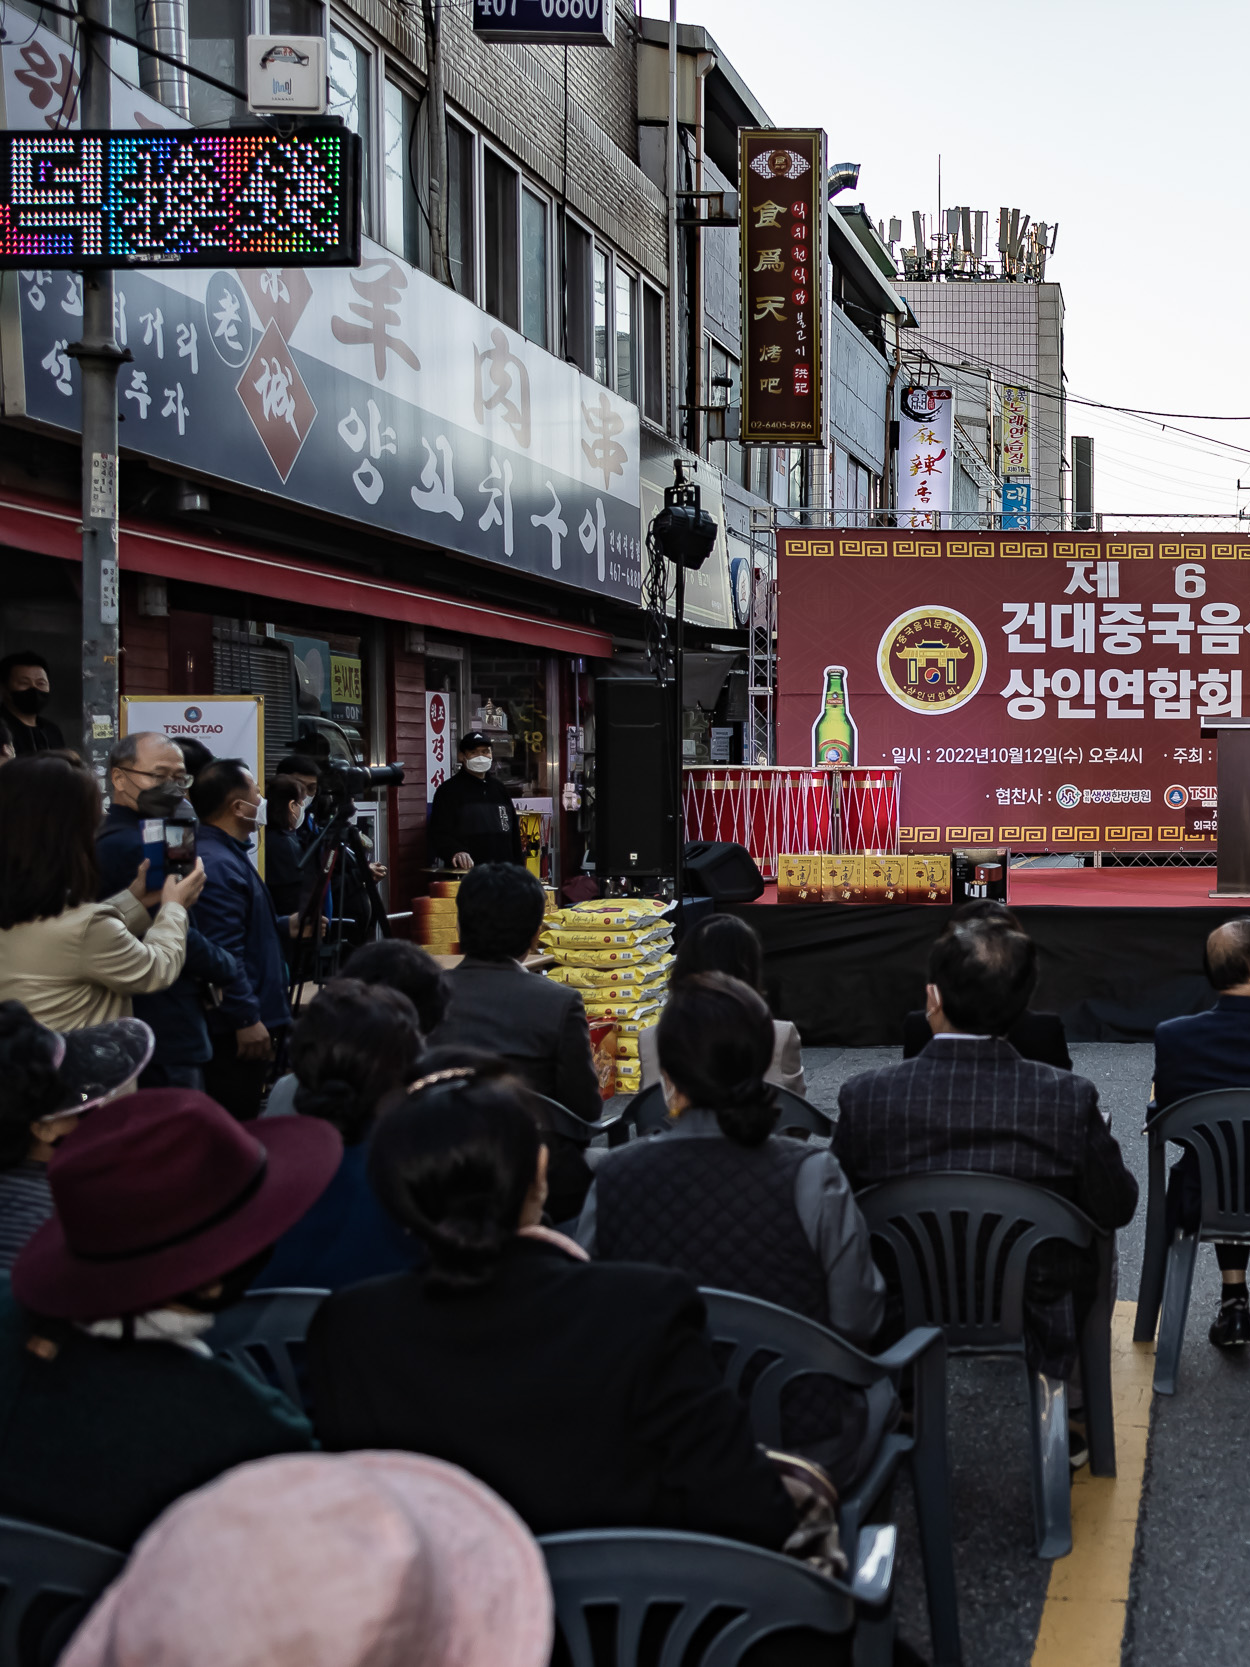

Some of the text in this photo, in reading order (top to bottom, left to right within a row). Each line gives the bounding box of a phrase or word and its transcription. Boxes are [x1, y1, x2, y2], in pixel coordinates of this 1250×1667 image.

[750, 421, 813, 430] 02-6405-8786
[1008, 402, 1025, 465] 노래연습장
[1063, 560, 1119, 598] 제
[1174, 562, 1207, 599] 6
[896, 618, 969, 646] 중국음식문화거리
[1000, 667, 1242, 720] 상인연합회
[163, 724, 224, 734] TSINGTAO
[891, 746, 1143, 765] 일시 2022년10월12일(수) 오후4시
[1172, 747, 1203, 764] 주최
[995, 787, 1044, 805] 협찬사
[1091, 789, 1151, 803] 생생한방병원
